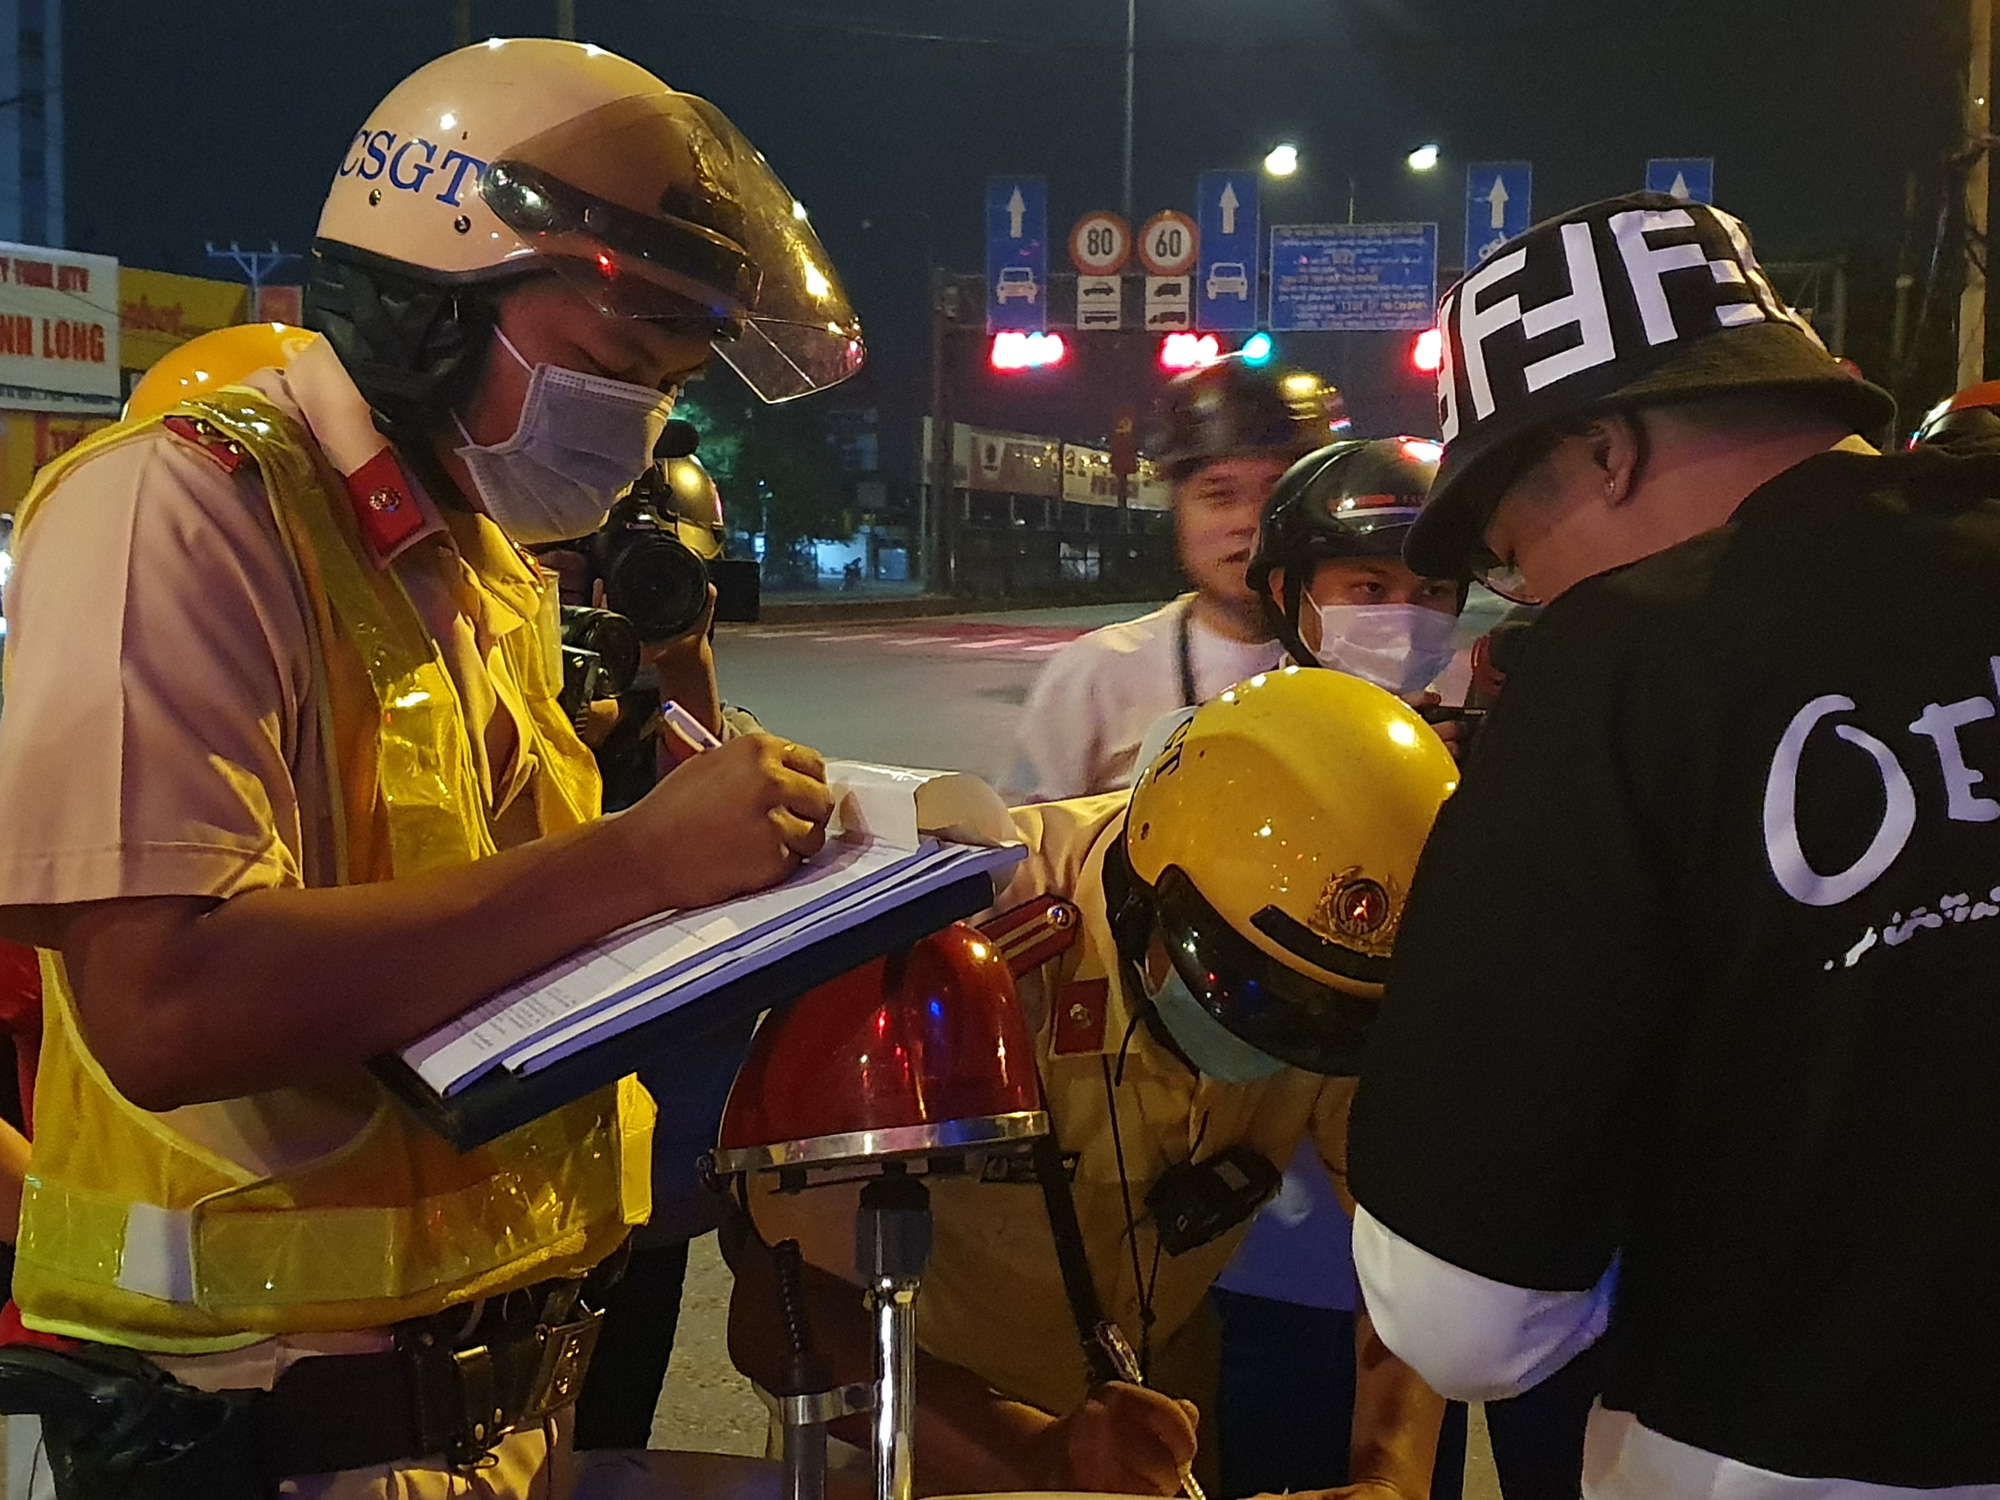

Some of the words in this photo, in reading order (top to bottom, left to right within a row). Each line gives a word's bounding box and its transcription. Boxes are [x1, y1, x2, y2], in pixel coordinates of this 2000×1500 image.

[338, 129, 488, 208] CSGT
[1086, 227, 1114, 256] 80
[1155, 229, 1182, 258] 60
[42, 317, 106, 365] LONG
